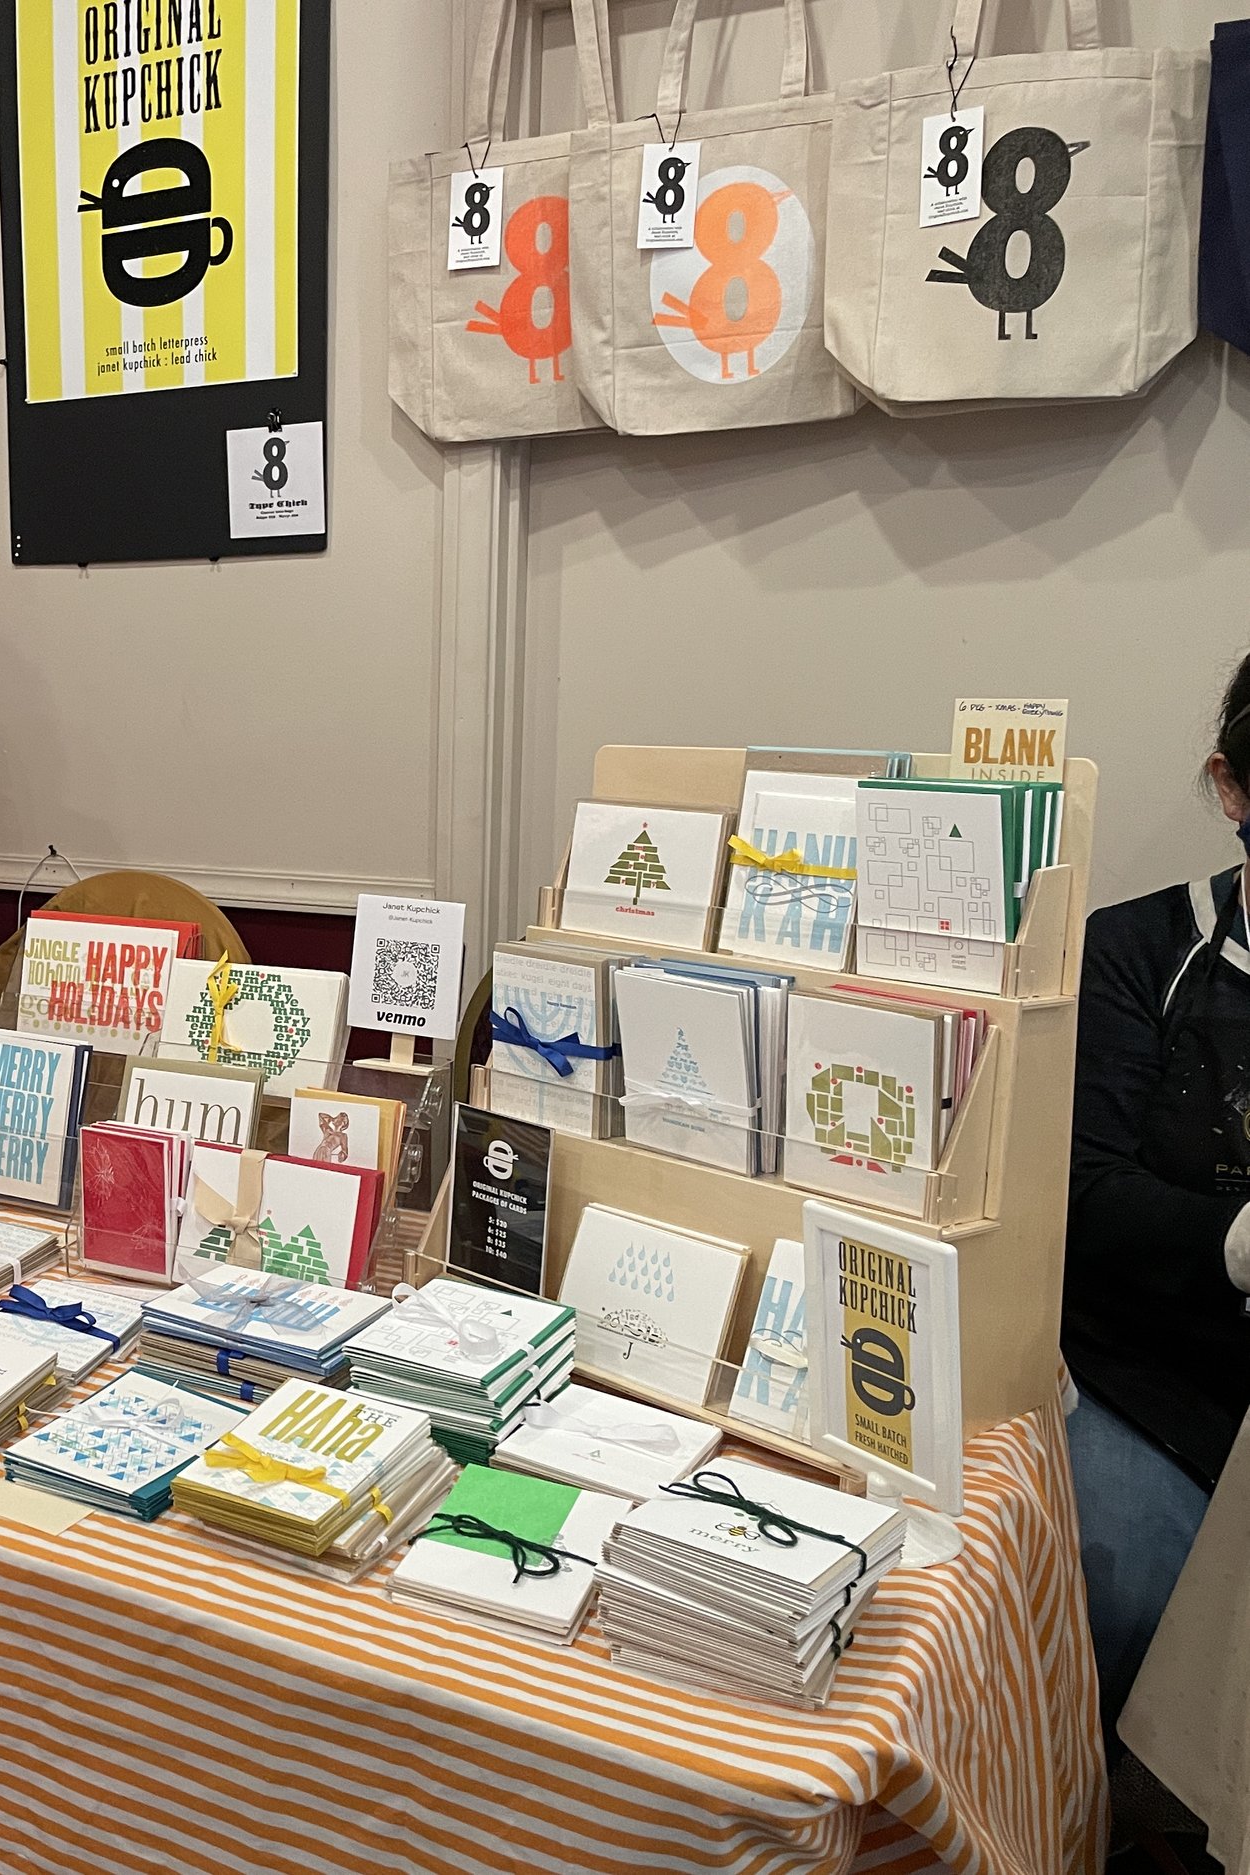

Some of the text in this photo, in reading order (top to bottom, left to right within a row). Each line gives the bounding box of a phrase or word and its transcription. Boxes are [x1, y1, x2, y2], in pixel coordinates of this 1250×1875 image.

[84, 0, 222, 65] ORIGINAL
[84, 49, 222, 133] KUPCHICK
[106, 335, 208, 357] small batch letterpress
[97, 347, 217, 376] janet kupchick lead chick
[963, 727, 1056, 767] BLANK
[971, 767, 1045, 781] INSIDE
[383, 902, 440, 914] Janet Kupchick
[615, 906, 655, 917] christmas
[86, 941, 168, 988] HAPPY
[48, 980, 163, 1033] HOLIDAYS
[376, 1011, 426, 1027] venmo
[471, 1190, 527, 1215] PACKAGES OF CARDS
[472, 1180, 527, 1205] ORIGINAL KUPCHICK
[838, 1241, 917, 1298] ORIGINAL
[838, 1274, 917, 1334] KUPCHICK
[352, 1408, 398, 1429] THE
[854, 1413, 907, 1448] SMALL BATCH
[854, 1430, 909, 1465] FRESH HATCHED
[689, 1527, 762, 1552] merry
